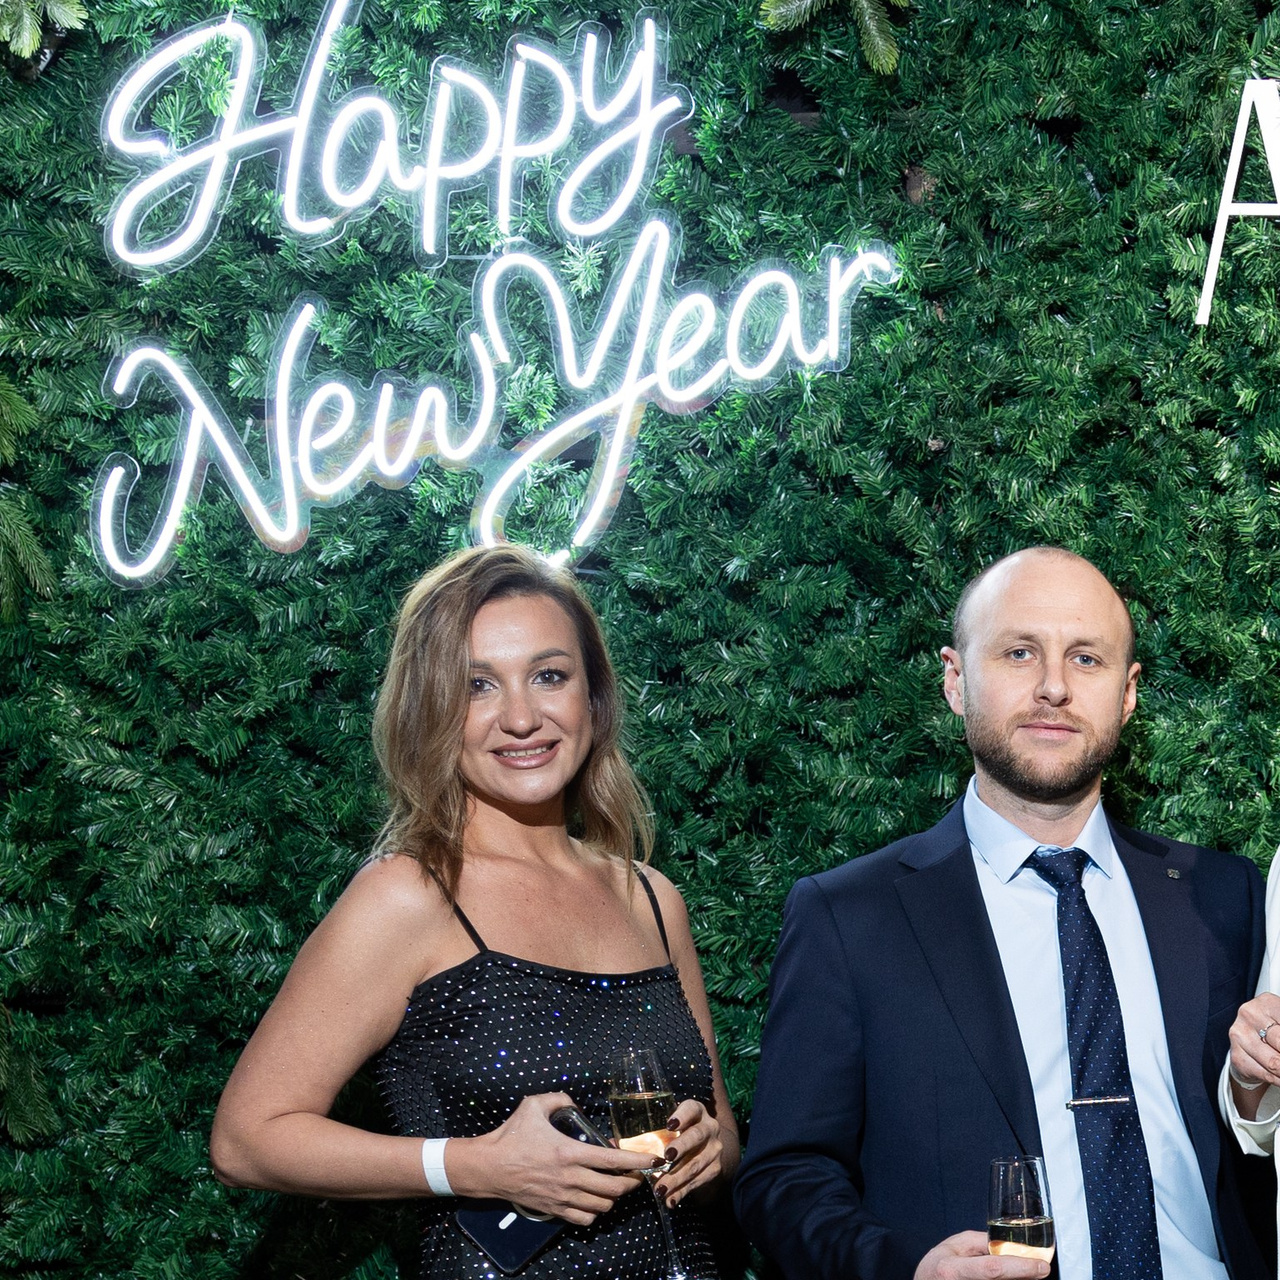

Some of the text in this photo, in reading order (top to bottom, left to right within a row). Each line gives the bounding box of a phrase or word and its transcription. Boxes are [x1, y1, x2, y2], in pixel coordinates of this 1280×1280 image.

[107, 0, 682, 266] Happy
[100, 219, 892, 578] New Year
